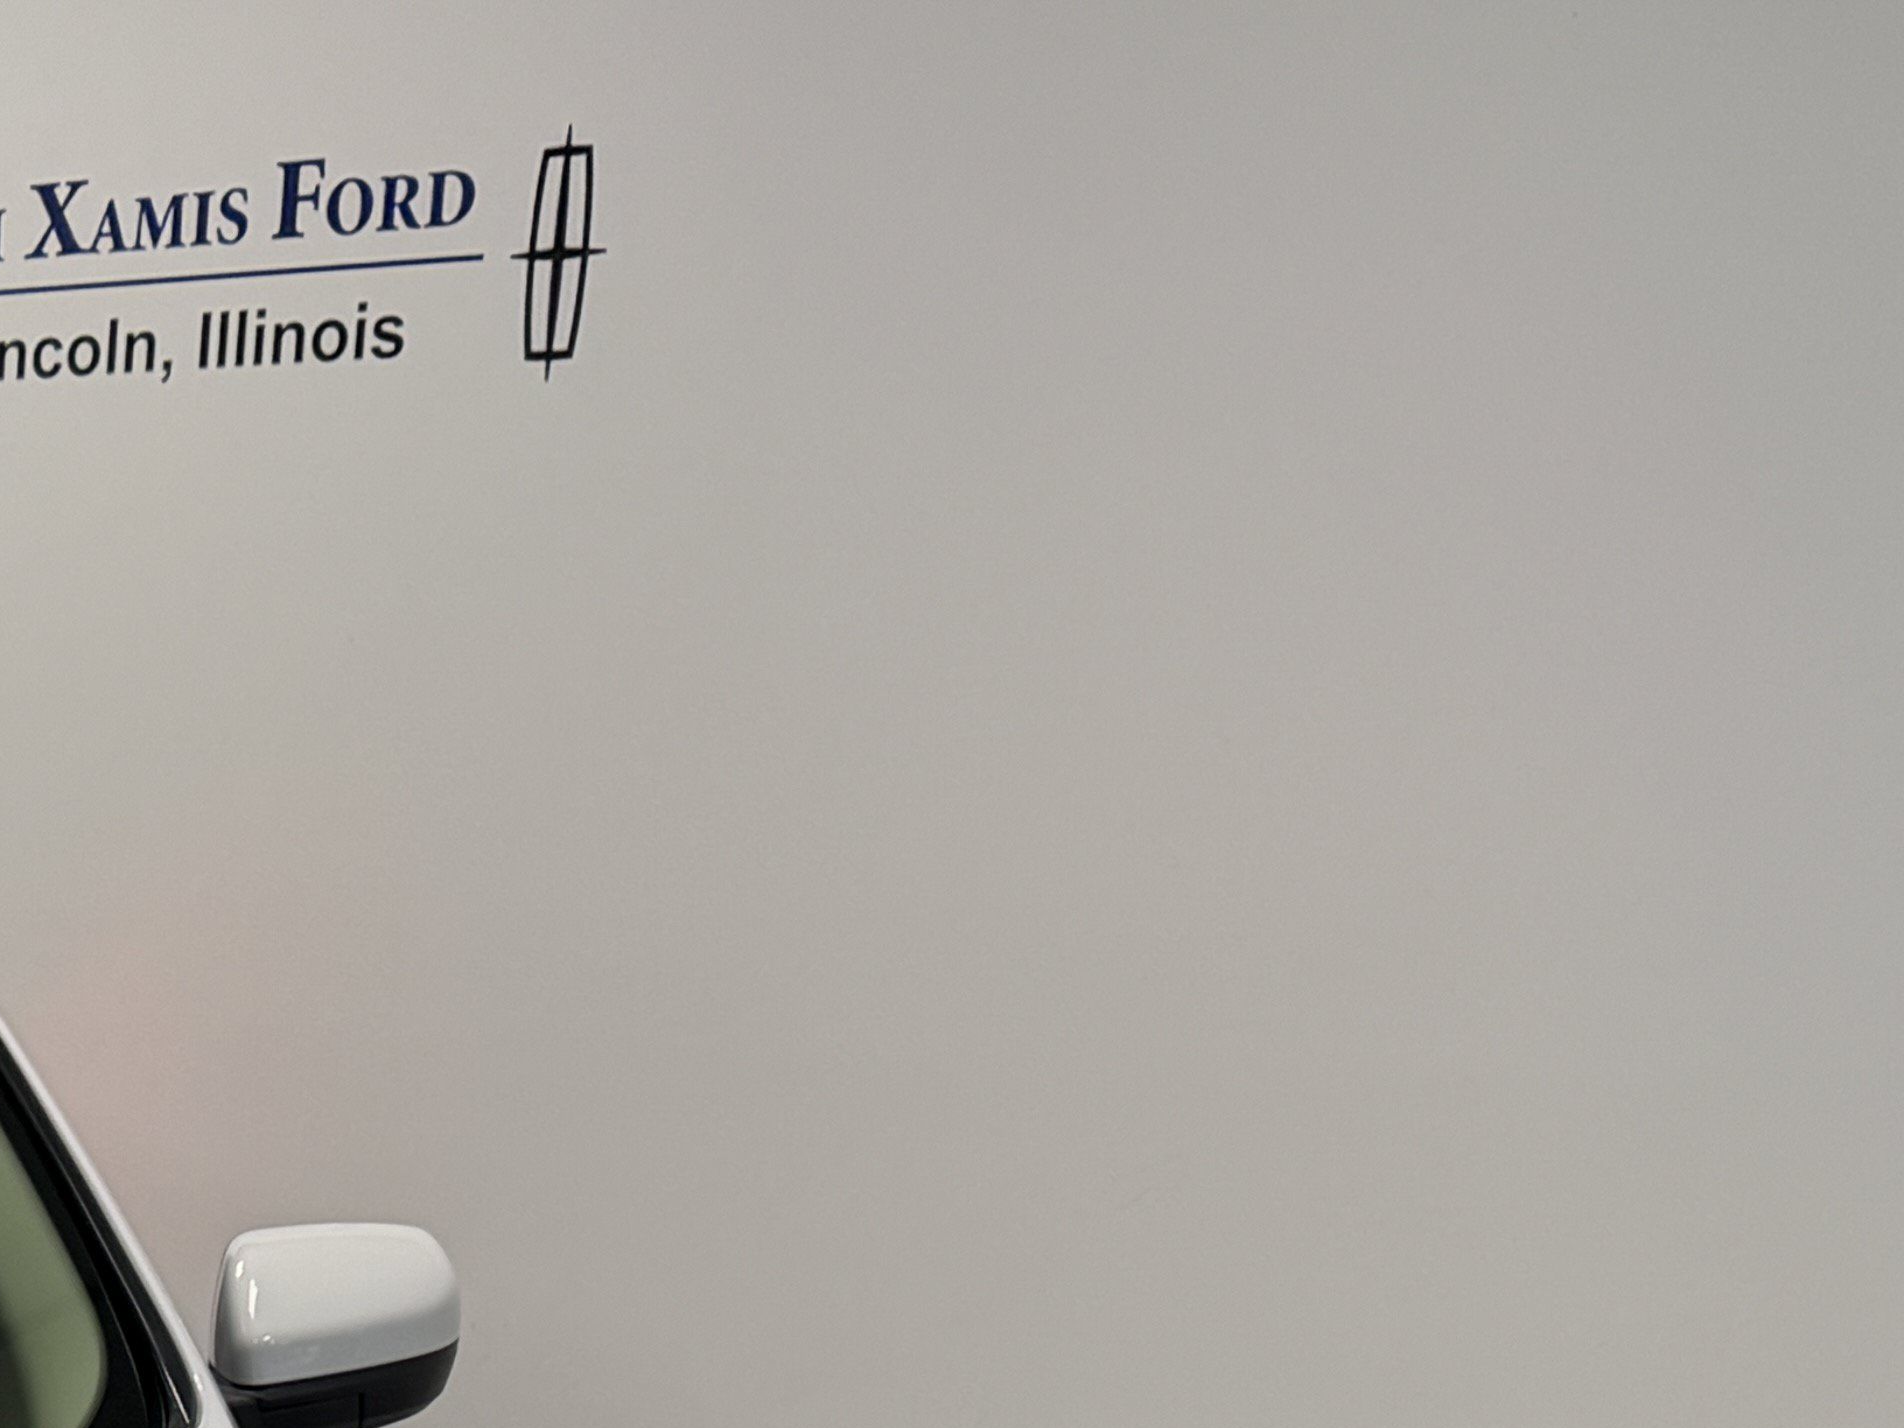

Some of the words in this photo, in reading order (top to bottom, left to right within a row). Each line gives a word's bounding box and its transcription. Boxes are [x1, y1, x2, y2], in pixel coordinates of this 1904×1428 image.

[25, 179, 249, 258] XAMIS
[274, 158, 475, 239] FORD
[198, 304, 404, 368] Illinois
